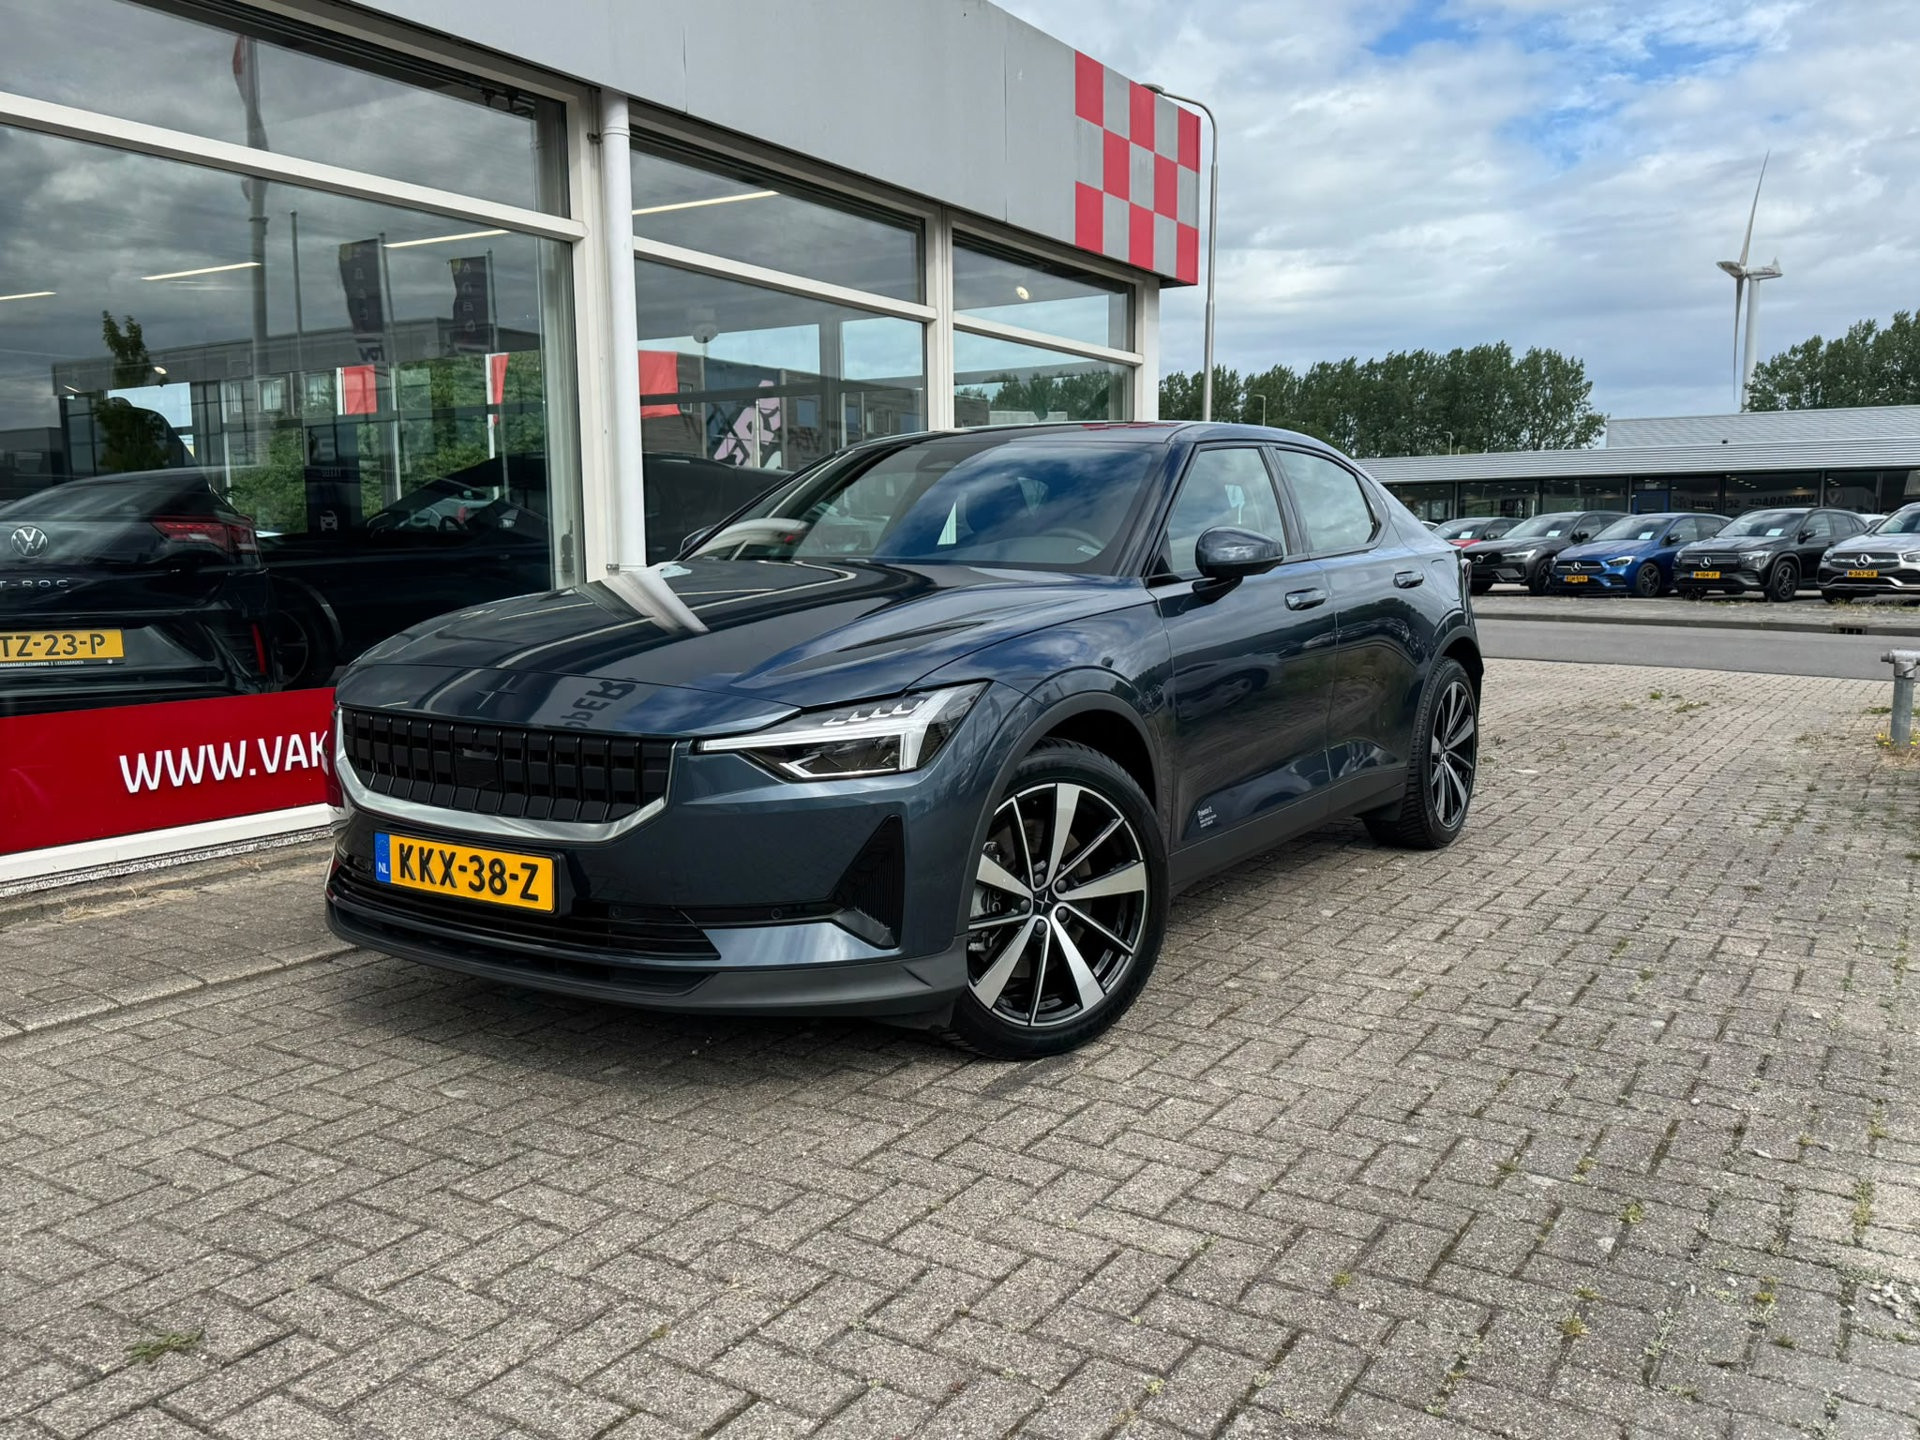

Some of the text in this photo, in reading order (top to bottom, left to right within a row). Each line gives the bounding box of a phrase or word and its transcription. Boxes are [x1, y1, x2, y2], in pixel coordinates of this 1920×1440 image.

[119, 730, 328, 793] WWW.VAK
[378, 862, 389, 874] NL
[399, 843, 540, 902] KKX-38-Z
